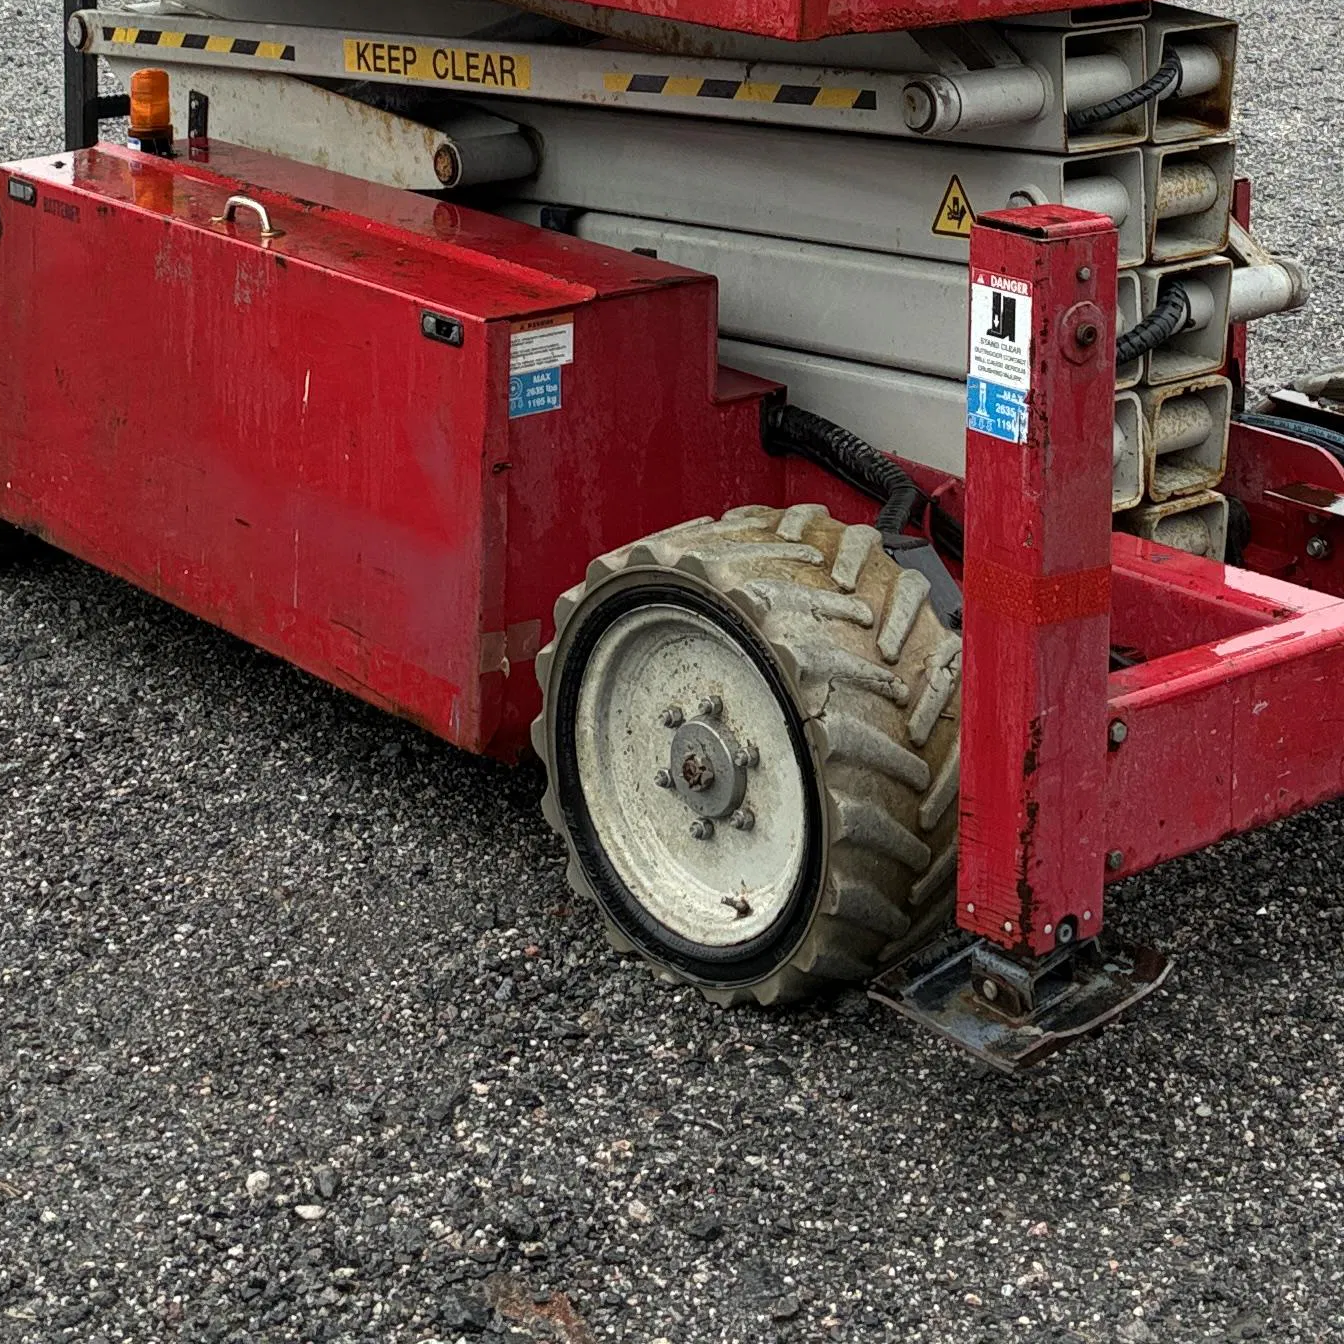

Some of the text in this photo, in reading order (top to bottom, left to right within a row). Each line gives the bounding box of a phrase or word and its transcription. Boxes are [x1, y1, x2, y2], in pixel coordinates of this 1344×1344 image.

[356, 41, 517, 87] KEEP CLEAR
[990, 274, 1029, 296] DANGER
[980, 337, 1022, 355] STAND CLEAR
[532, 372, 552, 384] MAX
